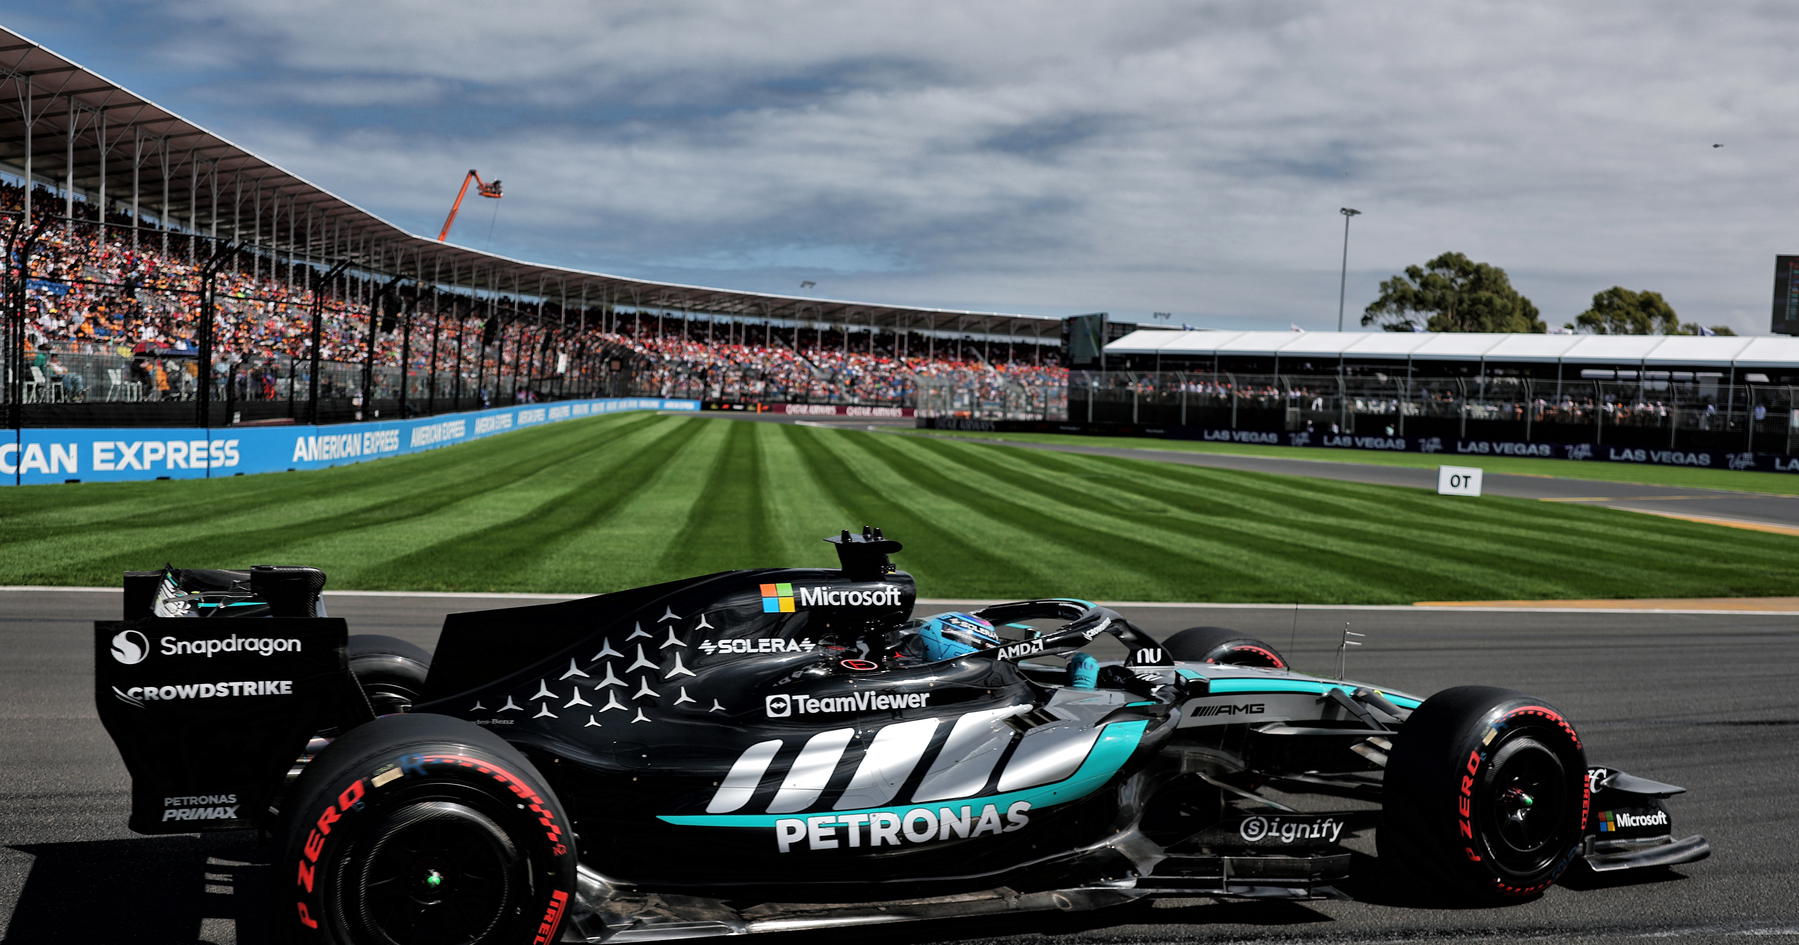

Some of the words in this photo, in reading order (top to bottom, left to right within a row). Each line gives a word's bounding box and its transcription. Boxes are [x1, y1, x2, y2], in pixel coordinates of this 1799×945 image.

[409, 423, 442, 448] AMERICAN
[442, 419, 465, 441] EXPRESS
[1204, 430, 1230, 440] LAS
[1232, 431, 1278, 443] VEGAS
[1323, 435, 1352, 446] LAS
[1354, 437, 1406, 449] VEGAS
[92, 439, 240, 471] EXPRESS
[293, 432, 362, 462] AMERICAN
[363, 429, 399, 455] EXPRESS
[1457, 441, 1489, 453] LAS
[1492, 443, 1551, 456] VEGAS
[1609, 448, 1647, 461] LAS
[1650, 450, 1711, 465] VEGAS
[1450, 474, 1471, 488] OT
[799, 585, 901, 606] Microsoft
[160, 634, 301, 657] Snapdragon
[717, 638, 802, 654] SOLERA
[997, 639, 1043, 660] AMD
[127, 680, 293, 701] CROWDSTRIKE
[791, 691, 929, 714] TeamViewer
[1213, 703, 1265, 716] AMG
[164, 794, 237, 807] PETRONAS
[1459, 750, 1481, 839] ZERO
[162, 805, 239, 822] PRIMAX
[1615, 810, 1668, 828] Microsoft
[297, 779, 366, 893] ZERO
[776, 801, 1032, 853] PETRONAS
[297, 902, 318, 929] P
